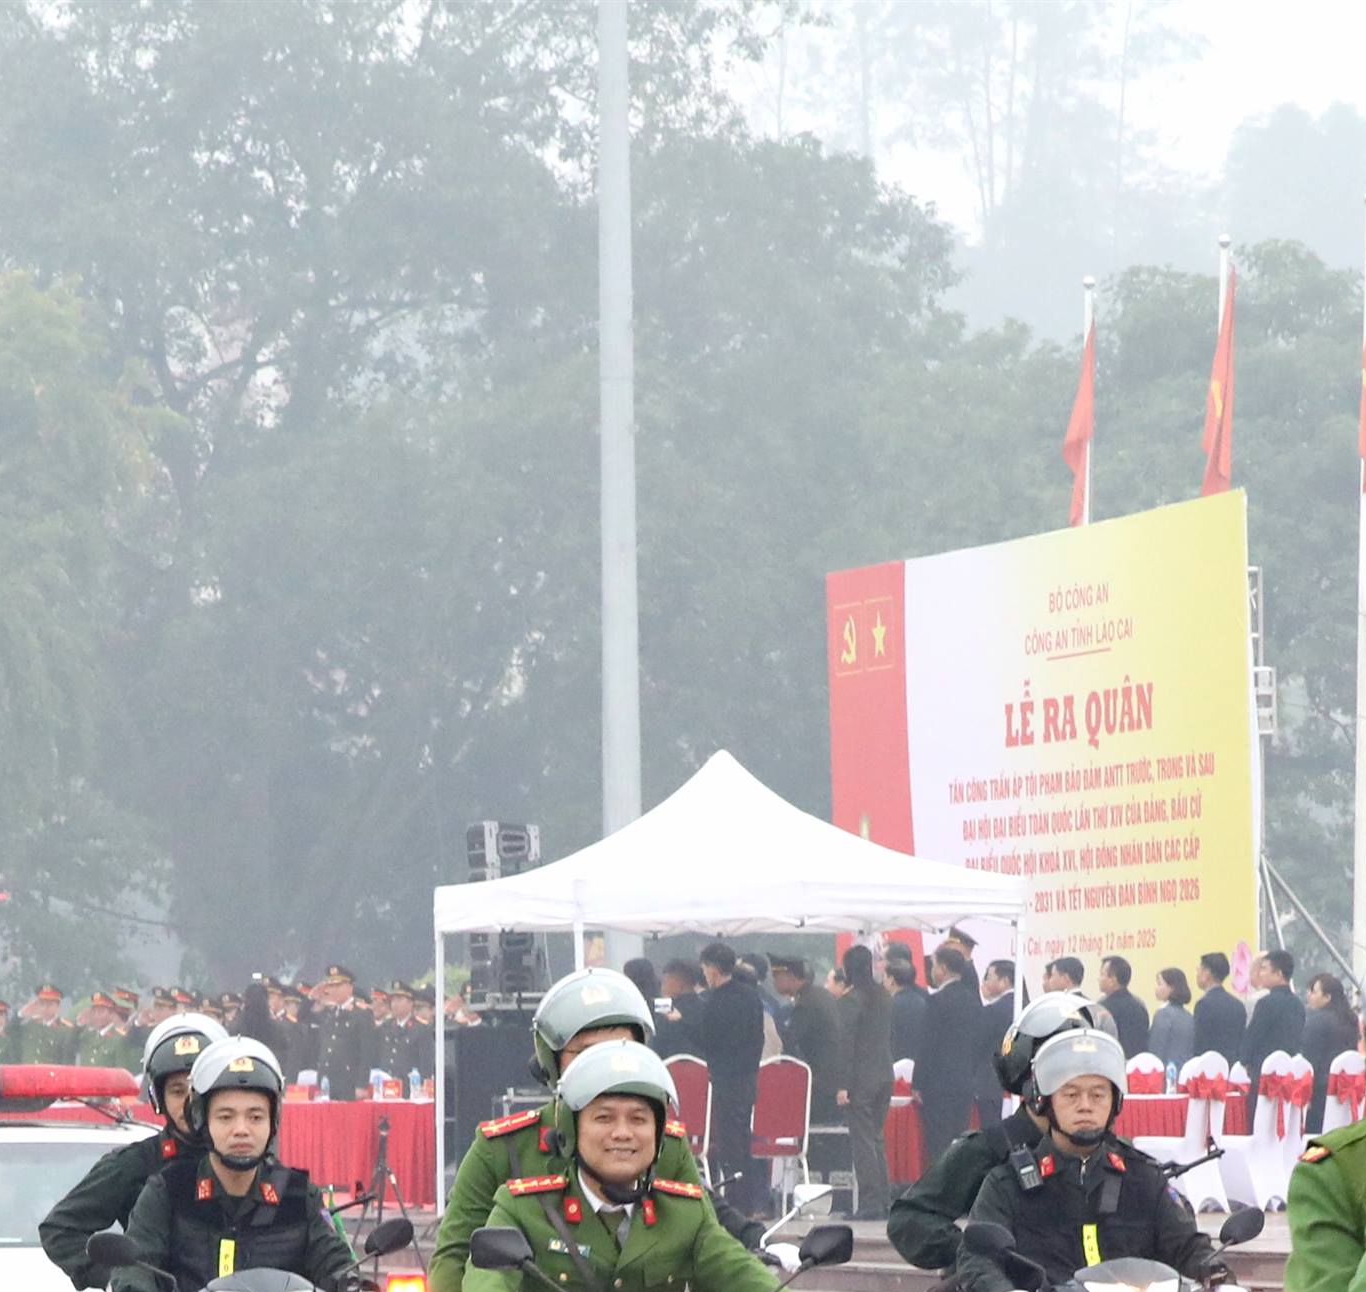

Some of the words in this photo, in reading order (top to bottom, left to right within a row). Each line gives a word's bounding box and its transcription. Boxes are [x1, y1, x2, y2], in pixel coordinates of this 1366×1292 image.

[1065, 582, 1093, 610] CÔNG
[1096, 582, 1109, 605] AN
[1025, 627, 1052, 655] CÔNG
[1055, 628, 1068, 650] AN
[1117, 617, 1133, 641] CAI
[1005, 677, 1034, 748] LỄ
[1043, 694, 1077, 743] RA
[1085, 674, 1153, 750] QUÂN
[1104, 764, 1123, 788] ANTT
[1157, 755, 1183, 780] TRONG
[1199, 752, 1214, 775] SAU
[1110, 804, 1123, 828] XIV
[1035, 890, 1053, 913] 2031
[1180, 877, 1200, 901] 2026
[1068, 935, 1076, 953] 12
[1106, 931, 1114, 951] 12
